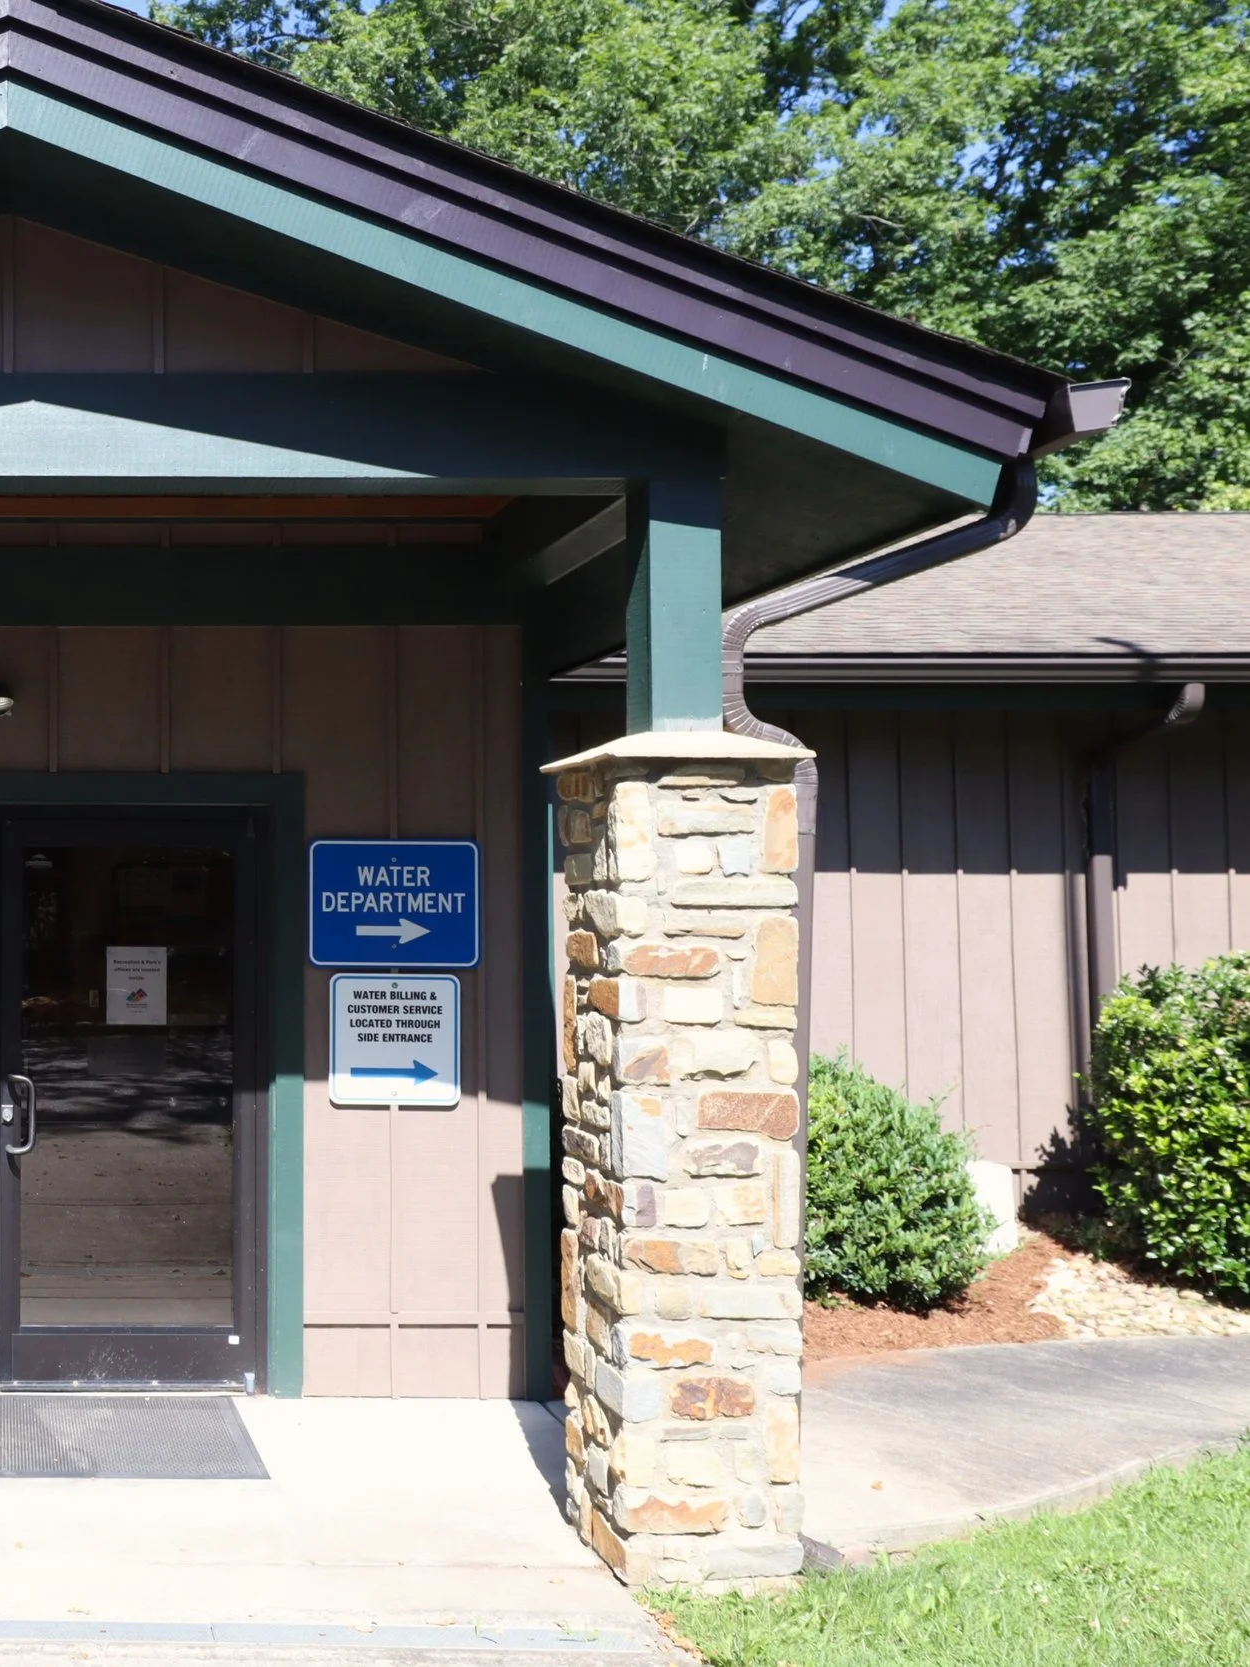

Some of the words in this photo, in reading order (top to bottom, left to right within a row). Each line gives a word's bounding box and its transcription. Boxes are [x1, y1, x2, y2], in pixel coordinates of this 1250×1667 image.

[357, 866, 431, 887] WATER
[321, 891, 466, 913] DEPARTMENT
[353, 990, 387, 1000] WATER
[389, 991, 427, 1001] BILLING
[429, 991, 438, 1001] &
[347, 1004, 400, 1014] CUSTOMER
[402, 1005, 443, 1015] SERVICE
[349, 1018, 392, 1028] LOCATED
[395, 1019, 441, 1029] THROUGH
[357, 1033, 379, 1042] SIDE
[382, 1033, 433, 1043] ENTRANCE
